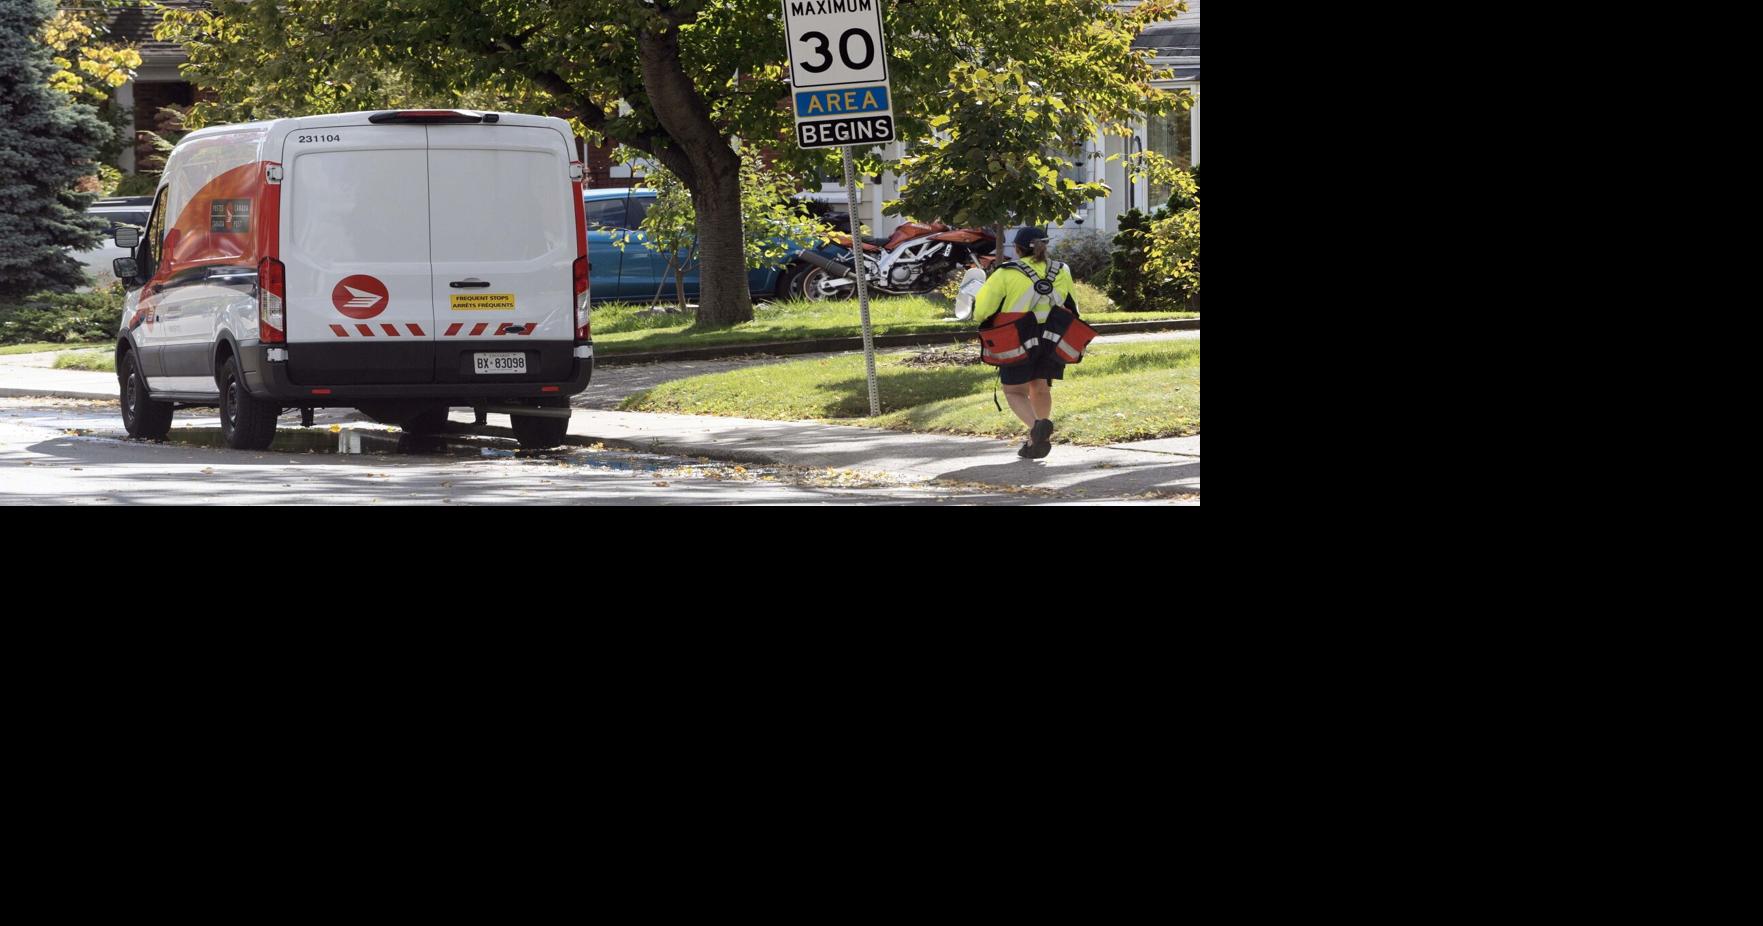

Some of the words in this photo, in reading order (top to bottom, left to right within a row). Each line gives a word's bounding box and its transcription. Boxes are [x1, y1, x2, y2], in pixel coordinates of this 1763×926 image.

[791, 0, 872, 16] MAXIMUM
[799, 28, 875, 73] 30
[808, 90, 879, 114] AREA
[298, 134, 341, 143] 231104
[801, 119, 890, 144] BEGINS
